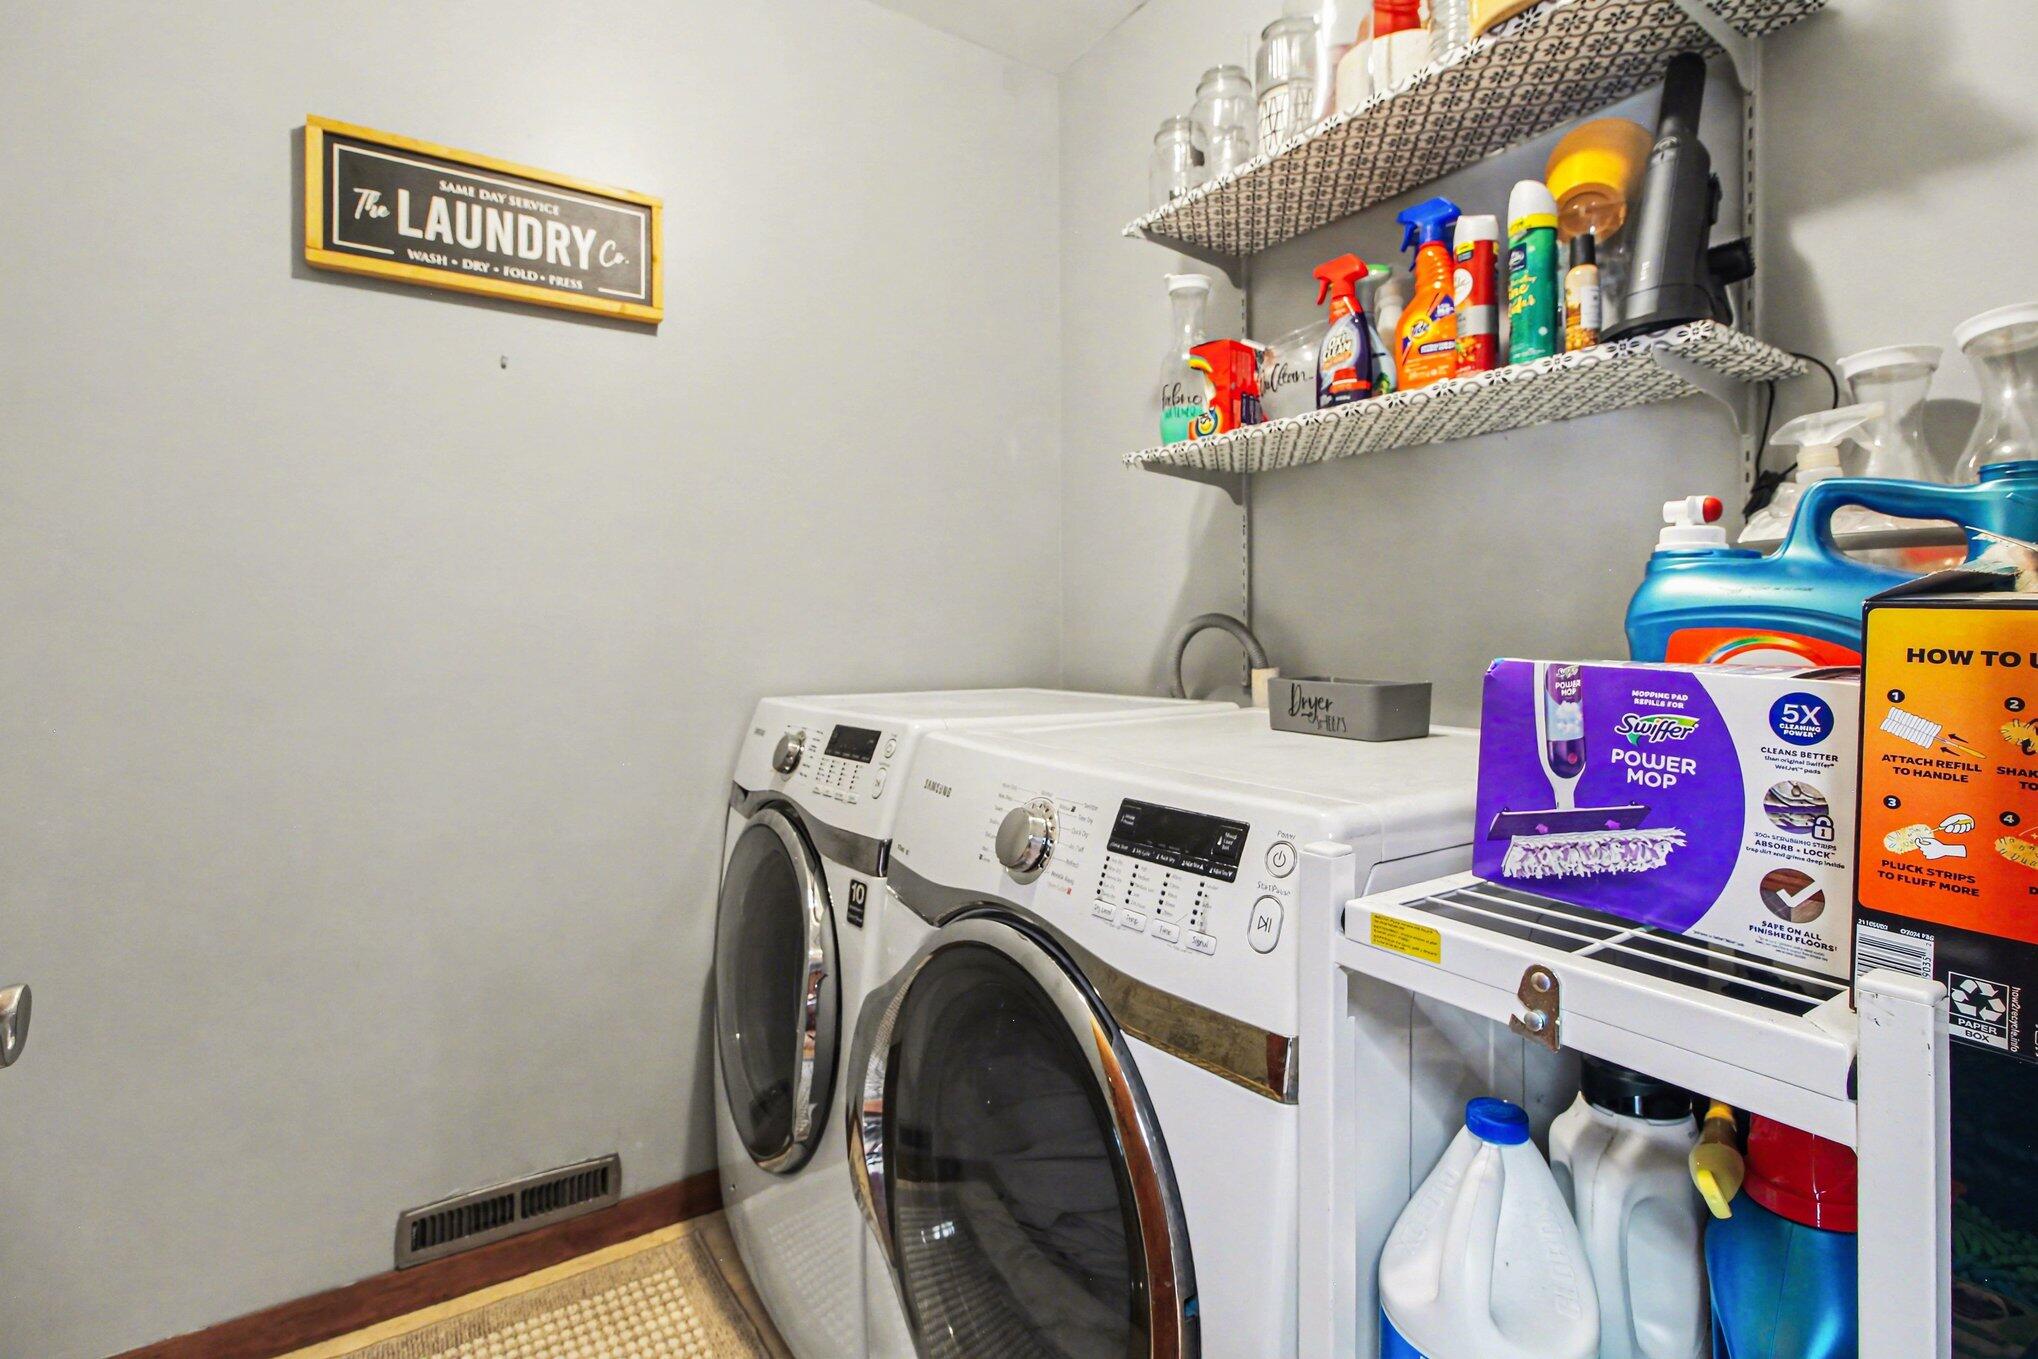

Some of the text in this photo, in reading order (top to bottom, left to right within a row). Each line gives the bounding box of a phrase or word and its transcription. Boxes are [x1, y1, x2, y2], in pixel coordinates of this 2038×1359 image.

[439, 179, 559, 216] SAME DAY SERVICE
[353, 187, 391, 220] The
[397, 188, 597, 270] LAUNDRY
[407, 248, 583, 291] WASH DRY FOLD PRESS
[1907, 648, 1974, 666] HOW
[1981, 651, 2022, 668] TO
[1555, 679, 1581, 689] POWER
[1561, 688, 1577, 696] MOP
[1288, 682, 1334, 724] Dryer
[1631, 690, 1688, 701] MOPPING PAD
[1633, 698, 1684, 709] REFILLS FOR
[2009, 700, 2020, 709] 2
[1781, 704, 1821, 726] 5X
[1615, 713, 1697, 743] Swiffer
[1780, 723, 1821, 733] CLEANING
[1611, 748, 1697, 776] POWER
[1761, 747, 1839, 762] CLEANS BETTER
[1780, 758, 1805, 766] original
[1881, 754, 1982, 773] ATTACH REFILL
[1626, 768, 1677, 789] MOP
[1893, 767, 1969, 783] TO HANDLE
[924, 778, 952, 798] SAMSUNG
[2003, 814, 2015, 824] 4
[1755, 840, 1794, 852] ABSORB
[1812, 842, 1837, 851] STRIPS
[1746, 846, 1759, 854] trap
[1806, 857, 1823, 865] deep
[1824, 860, 1845, 869] inside
[1881, 859, 1977, 884] PLUCK STRIPS
[1878, 870, 1980, 897] TO FLUFF MORE
[852, 883, 865, 904] 10
[1749, 925, 1793, 941] FINISHED
[1795, 937, 1838, 952] FLOORS!
[1762, 921, 1821, 940] SAFE ON ALL
[1957, 1018, 1998, 1035] PAPER
[2009, 986, 2021, 1053] how2recycle.info
[1965, 1030, 1990, 1043] BOX
